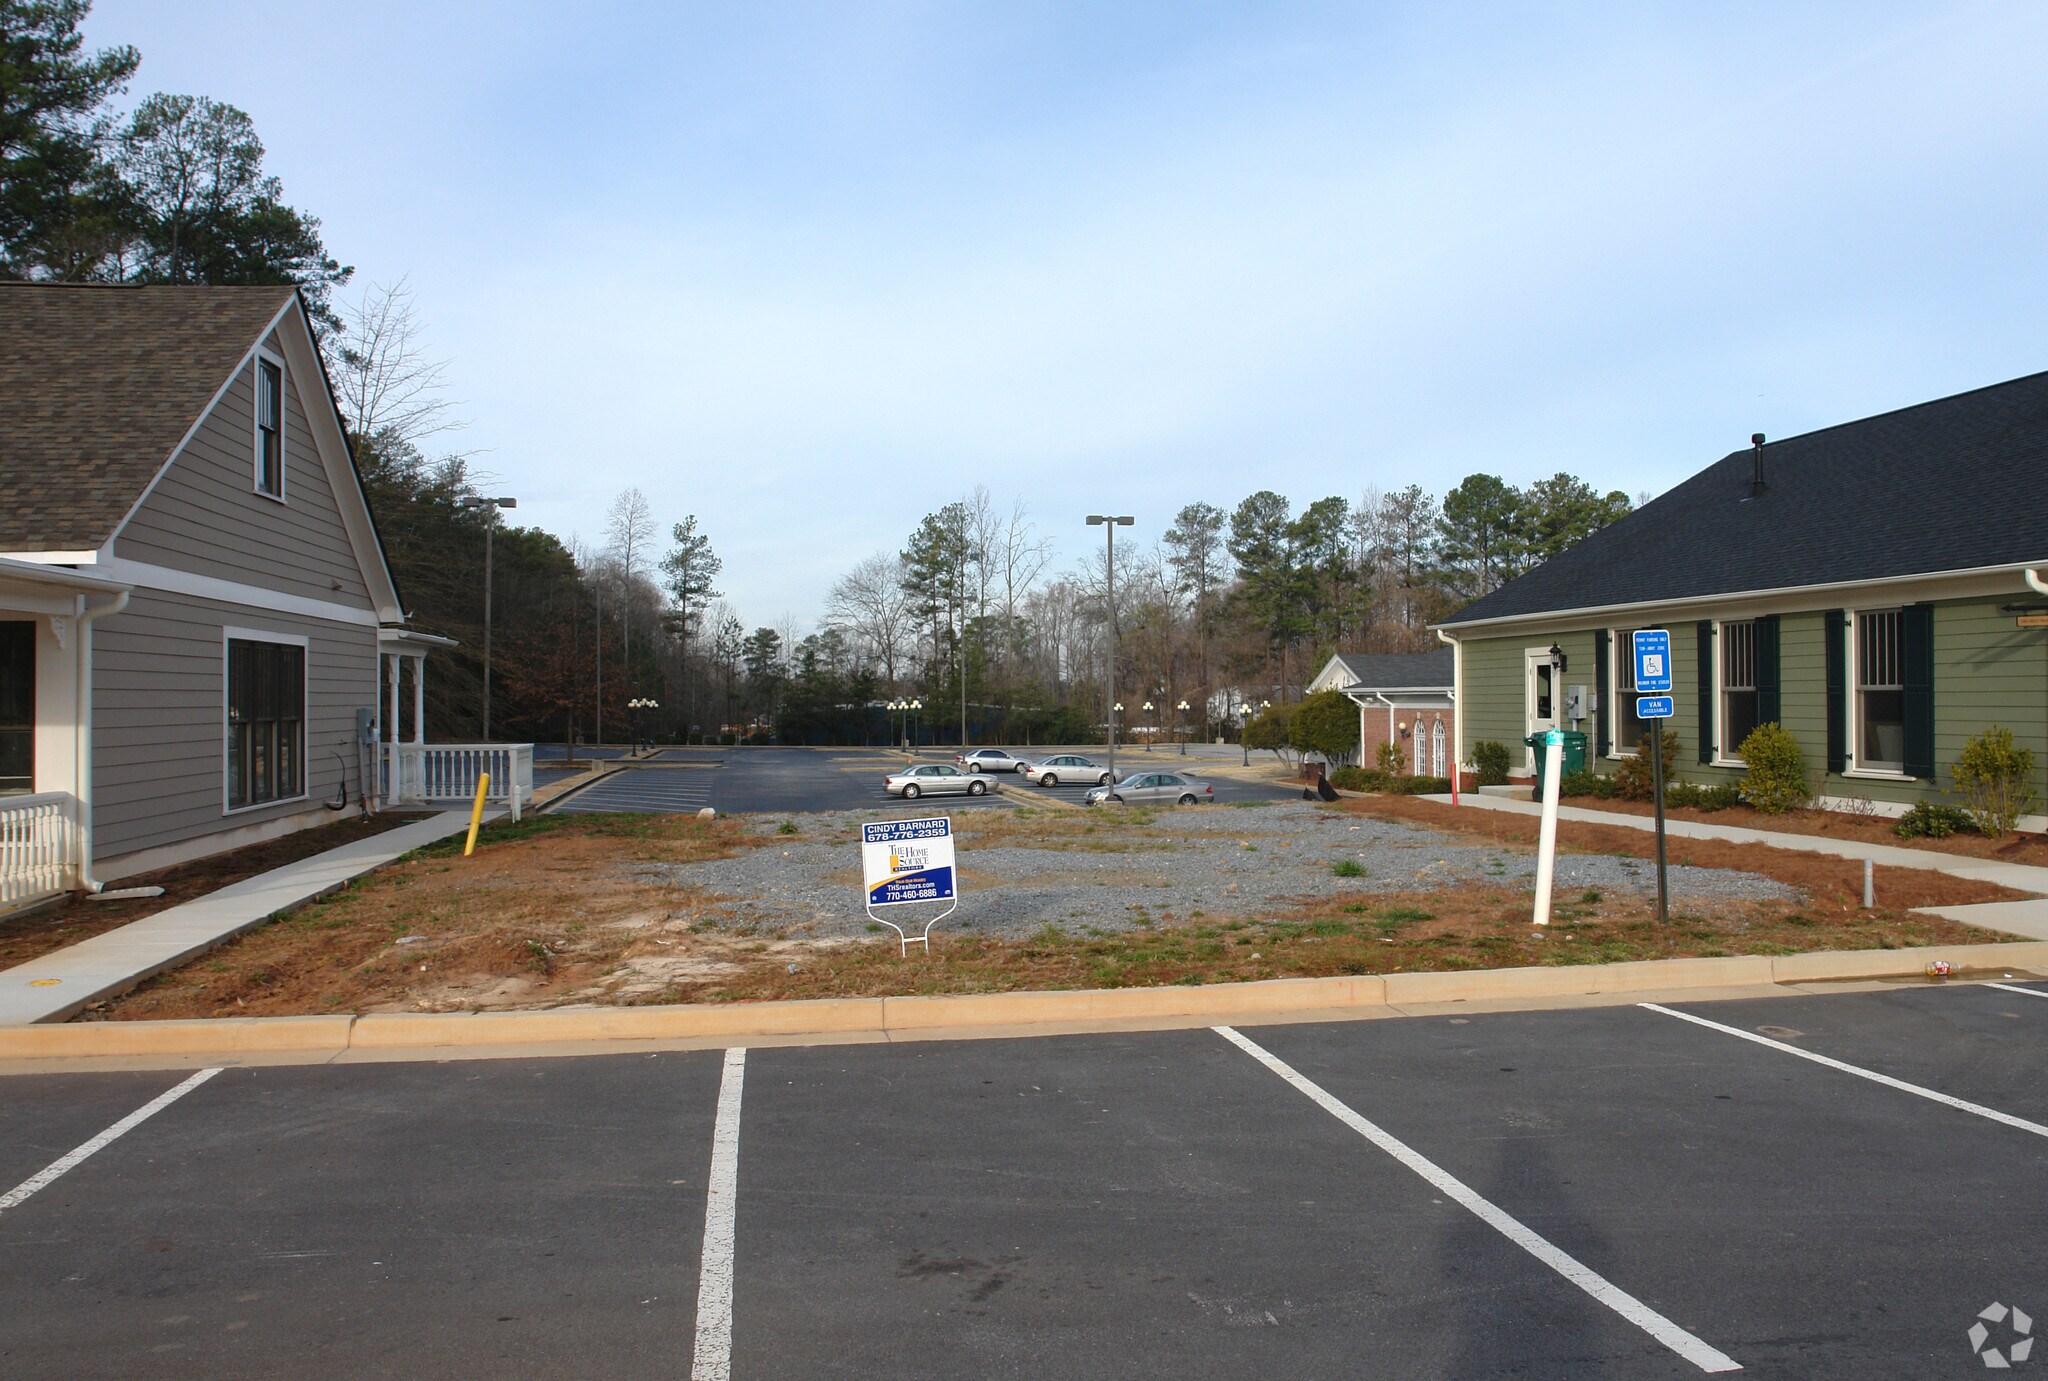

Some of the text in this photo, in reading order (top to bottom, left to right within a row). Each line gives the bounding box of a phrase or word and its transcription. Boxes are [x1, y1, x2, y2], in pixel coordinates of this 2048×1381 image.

[867, 820, 945, 834] CINDY BARNARD
[867, 828, 946, 842] 678-776-2359
[888, 844, 929, 858] THE HOME
[899, 856, 930, 866] SOURCE
[887, 882, 935, 891] THSrealtors.com
[886, 888, 937, 900] 770-460-6886
